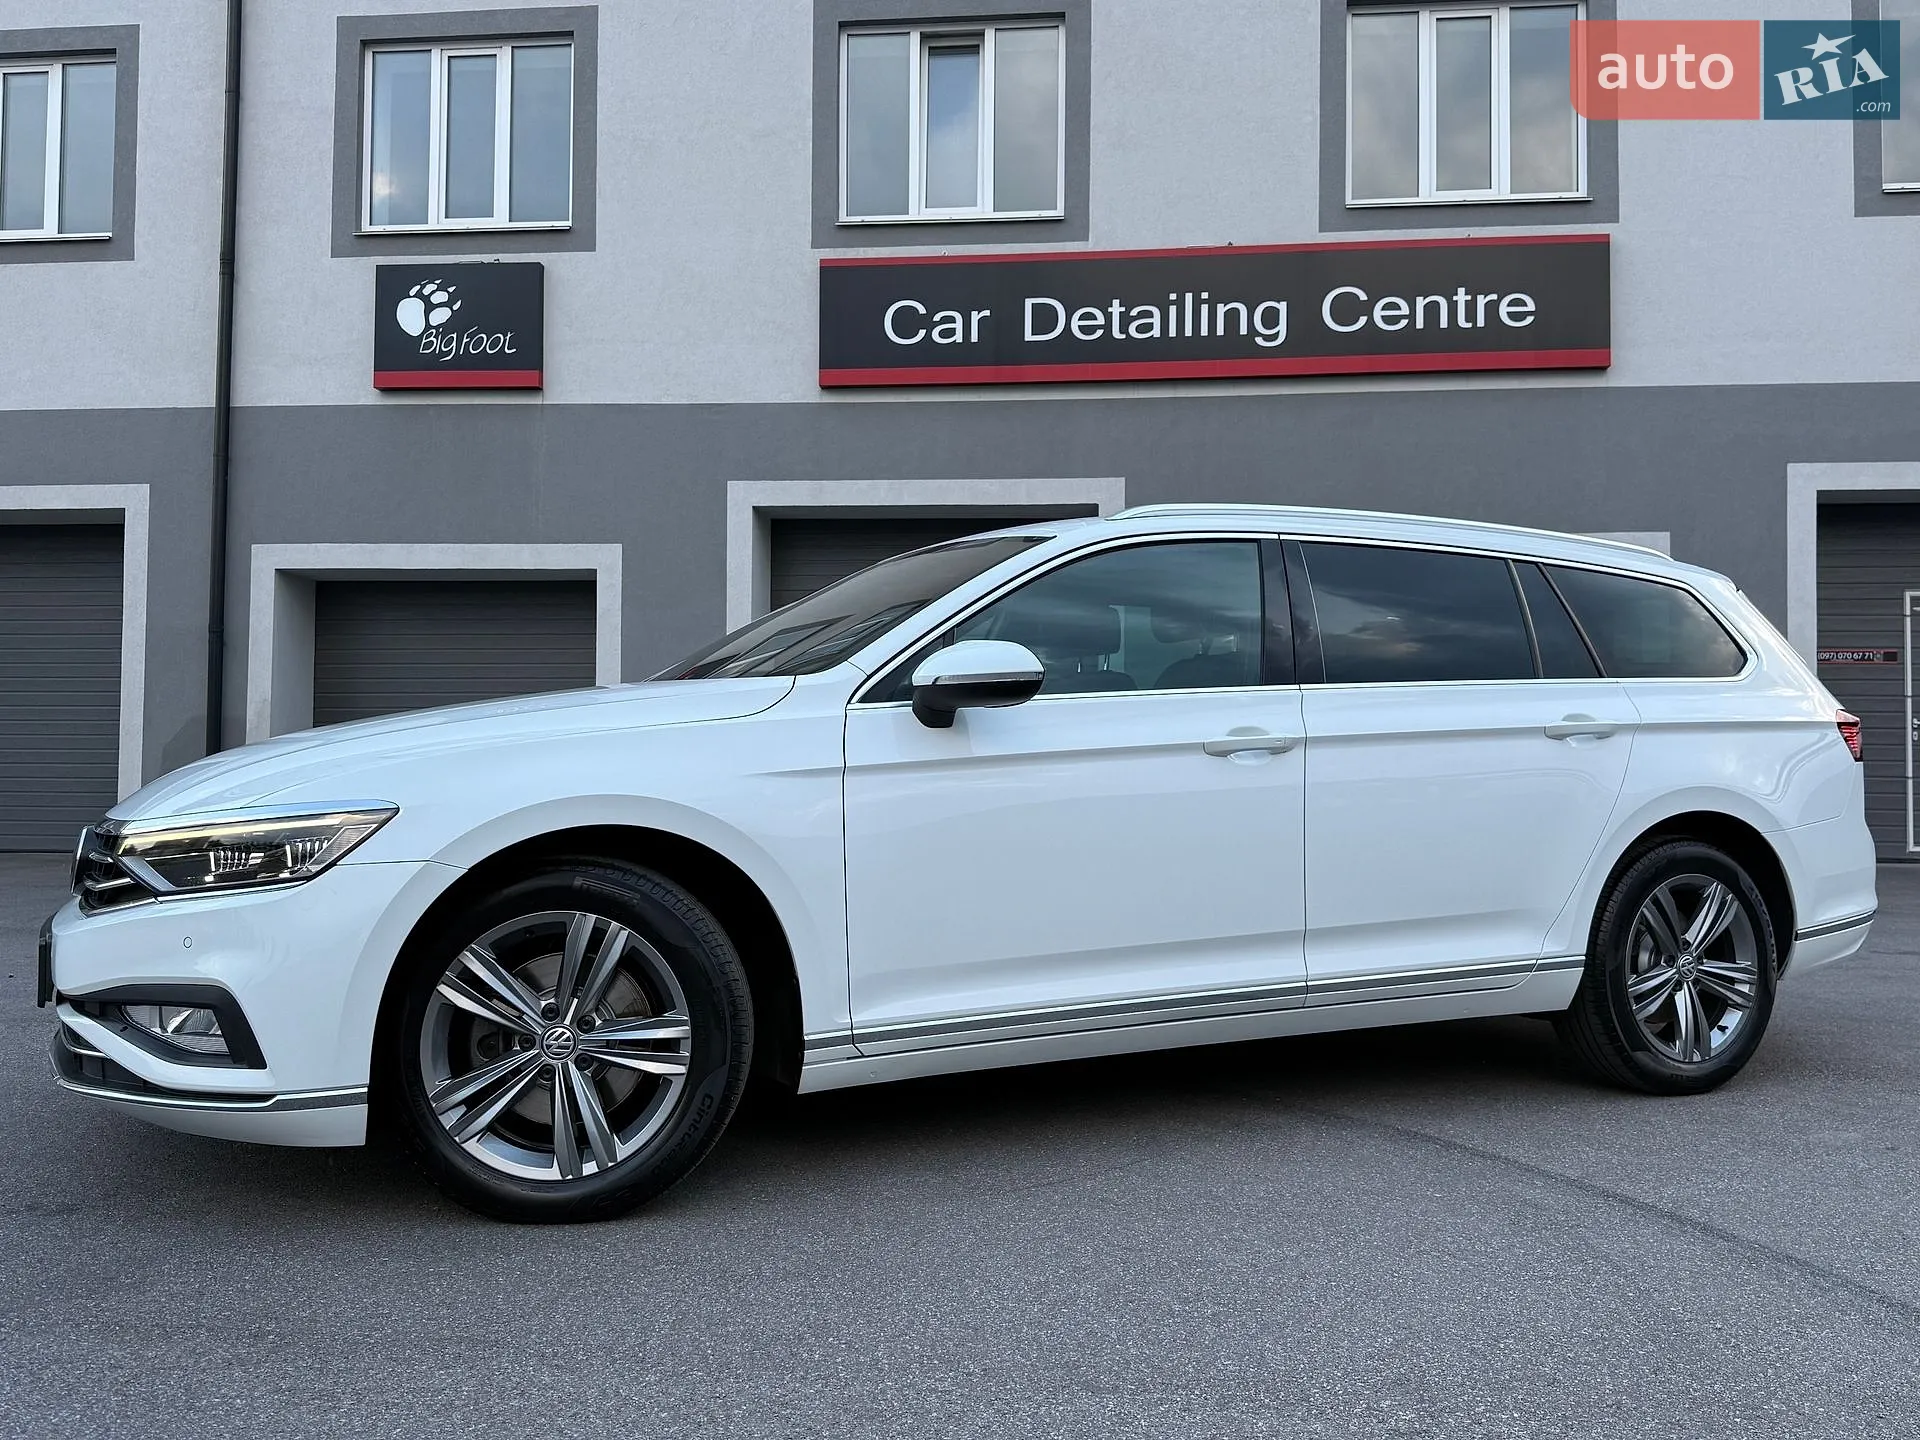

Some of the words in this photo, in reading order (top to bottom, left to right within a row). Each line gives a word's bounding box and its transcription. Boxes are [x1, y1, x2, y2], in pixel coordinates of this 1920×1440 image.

[884, 300, 990, 344] Car
[1025, 292, 1287, 346] Detailing
[1322, 287, 1535, 332] Centre
[1817, 651, 1836, 661] (097)
[1837, 652, 1852, 660] 070
[1853, 652, 1863, 660] 67
[1864, 652, 1873, 660] 71
